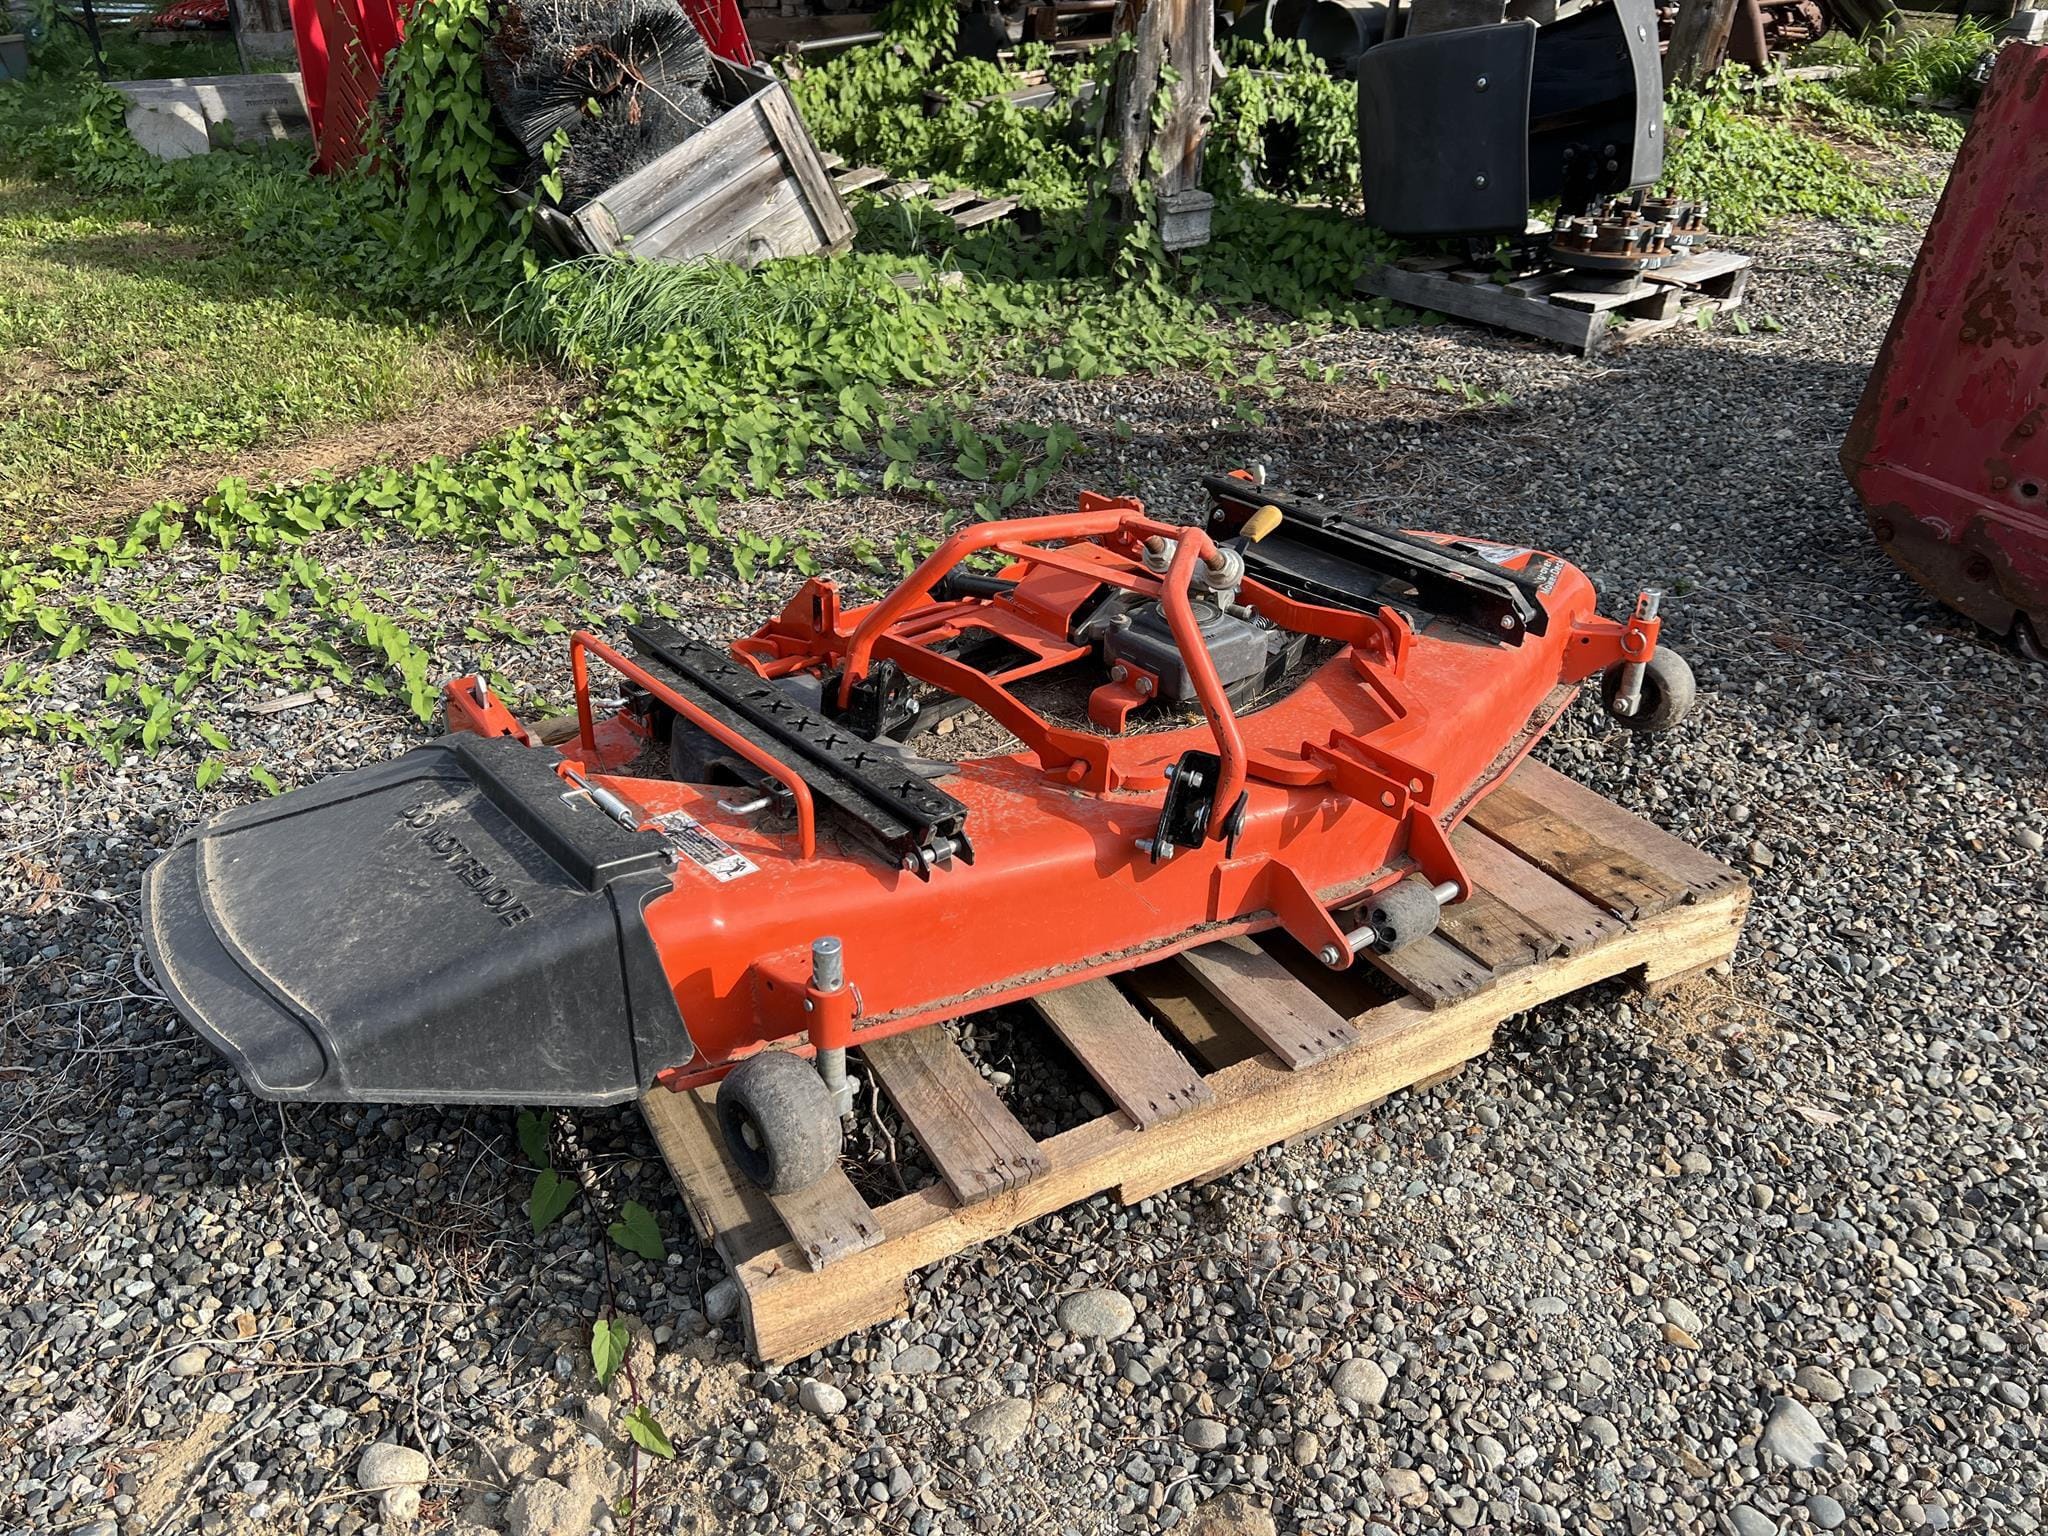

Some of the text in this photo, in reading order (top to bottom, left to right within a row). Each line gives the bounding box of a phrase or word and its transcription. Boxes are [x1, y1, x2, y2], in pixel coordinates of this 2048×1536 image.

[402, 804, 535, 928] DO NOT REMOVE
